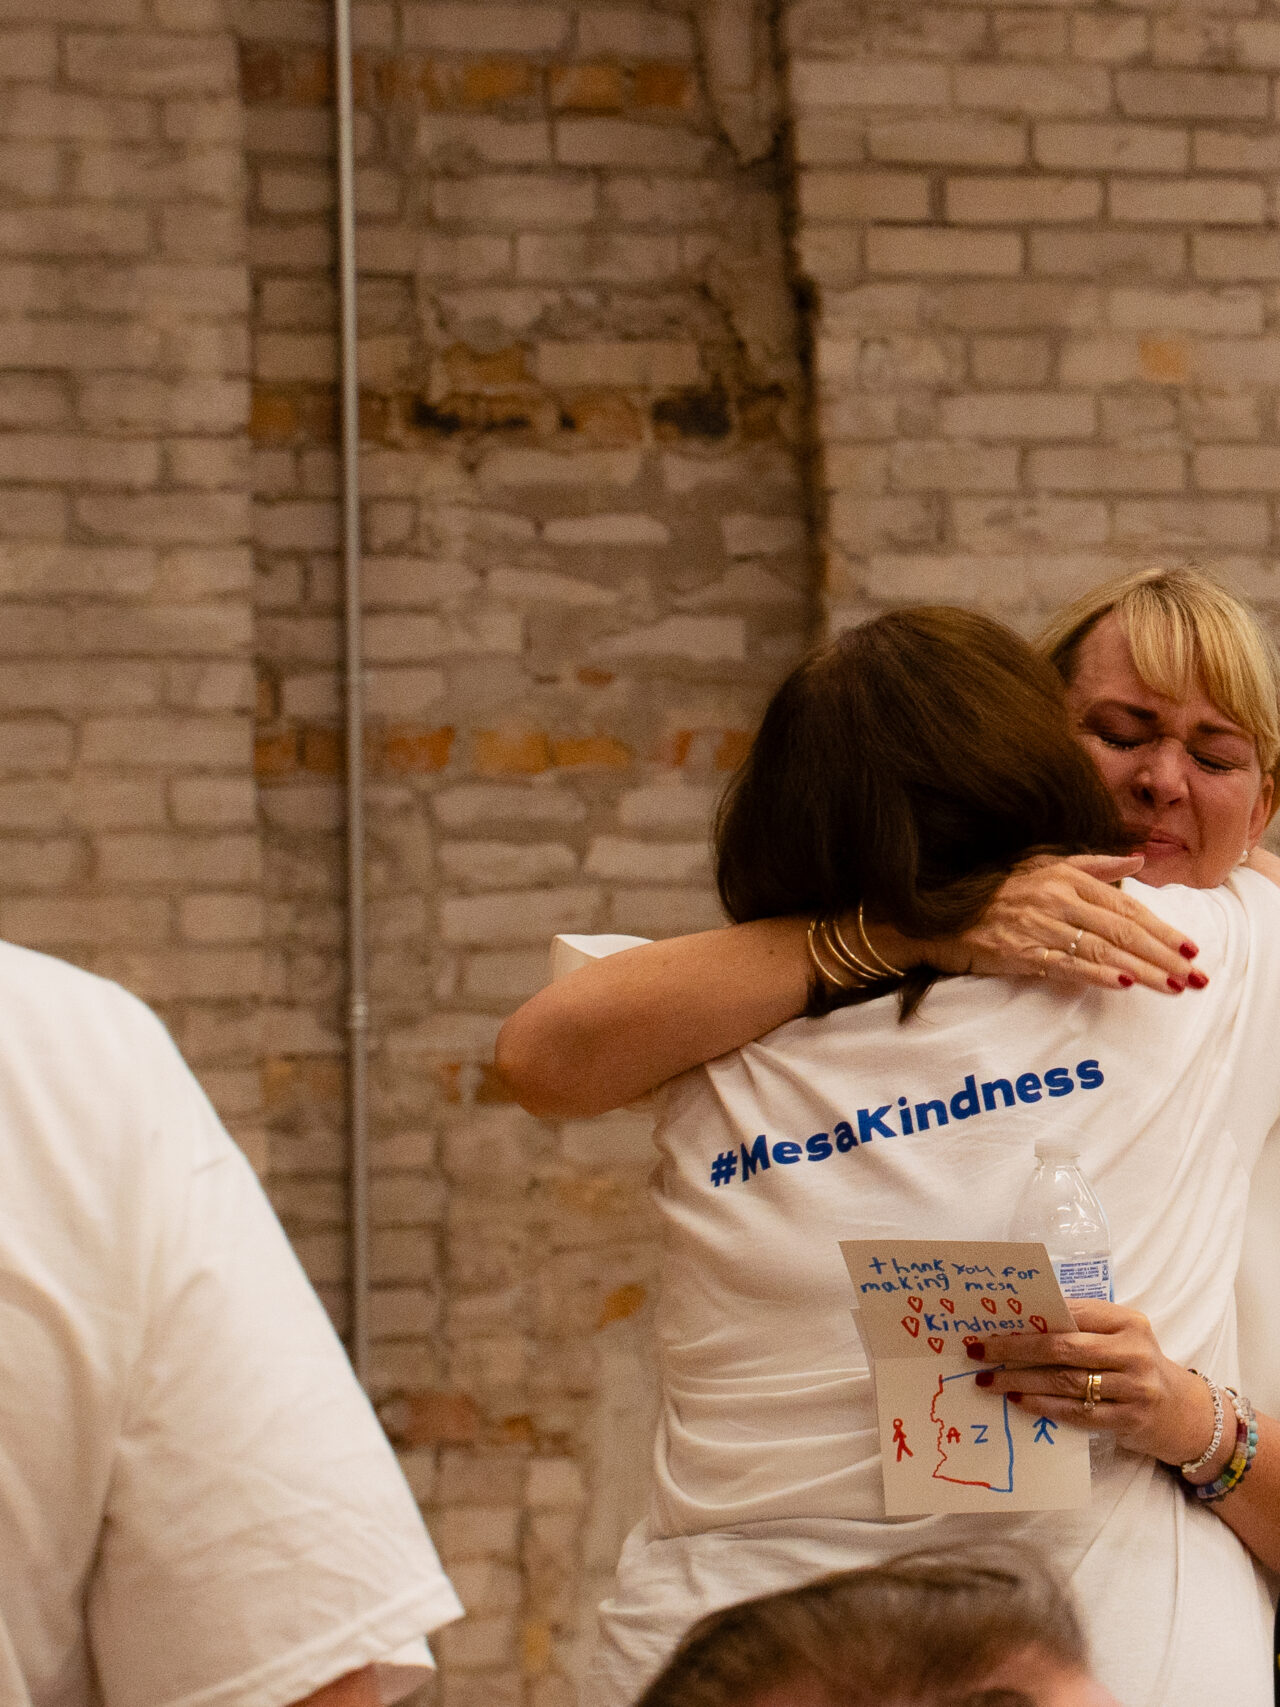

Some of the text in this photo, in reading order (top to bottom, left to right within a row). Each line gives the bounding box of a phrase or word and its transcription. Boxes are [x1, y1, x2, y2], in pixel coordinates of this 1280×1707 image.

[710, 1059, 1104, 1187] #MesaKindness
[869, 1256, 946, 1275] thank
[951, 1262, 996, 1278] you
[1002, 1266, 1041, 1280] for
[965, 1281, 1019, 1294] mesa
